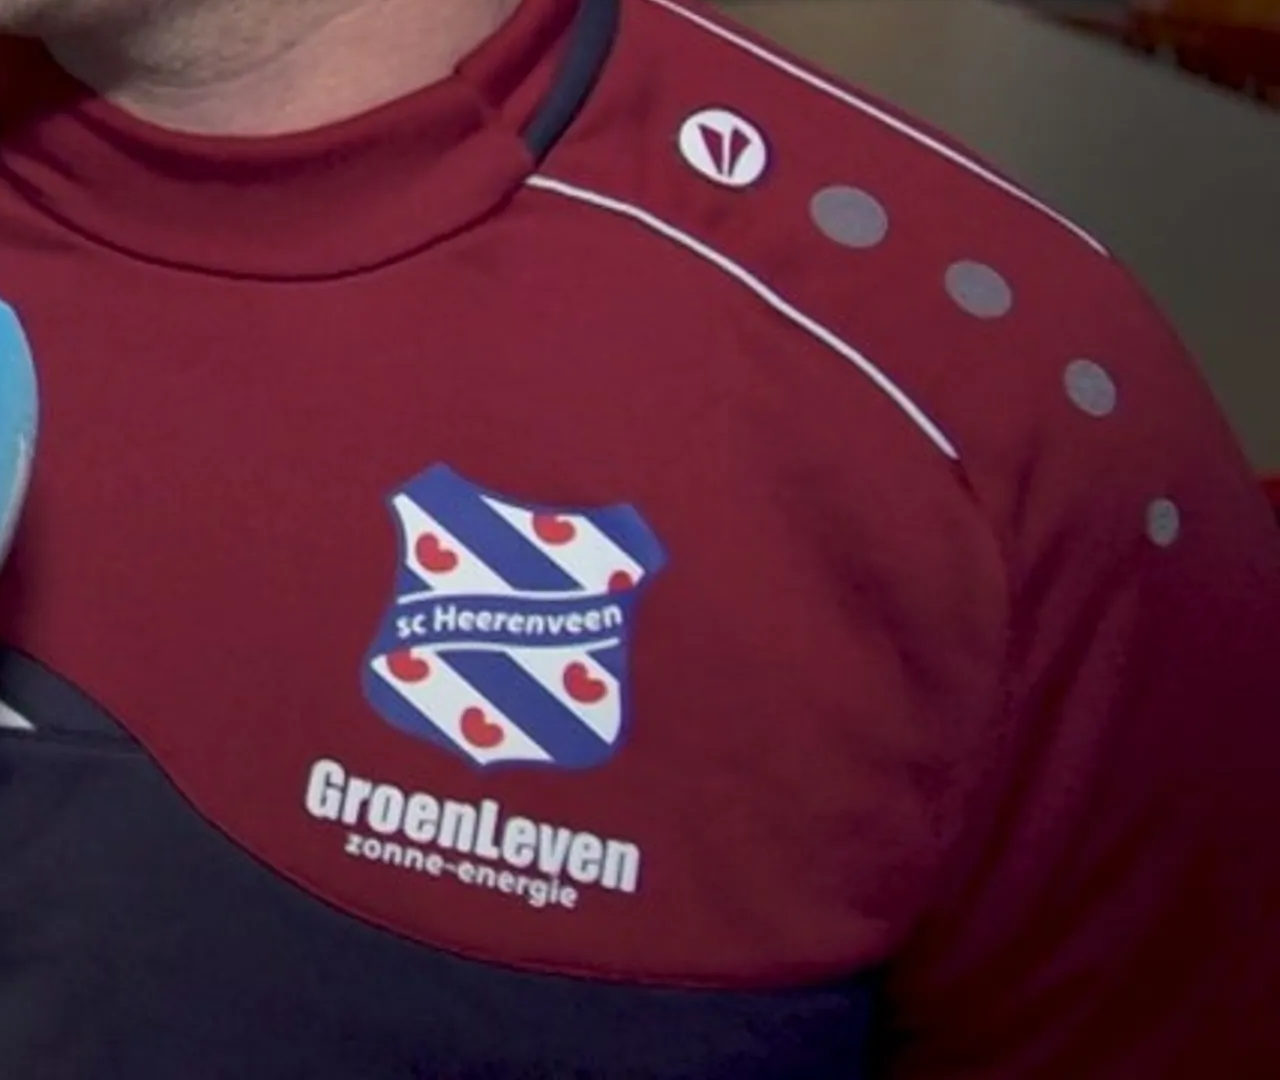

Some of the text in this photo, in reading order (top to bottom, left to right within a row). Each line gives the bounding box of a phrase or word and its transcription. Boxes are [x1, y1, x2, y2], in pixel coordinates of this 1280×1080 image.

[433, 604, 624, 636] Heerenveen
[305, 758, 640, 893] GroenLeven
[344, 831, 579, 908] zonne-energie
